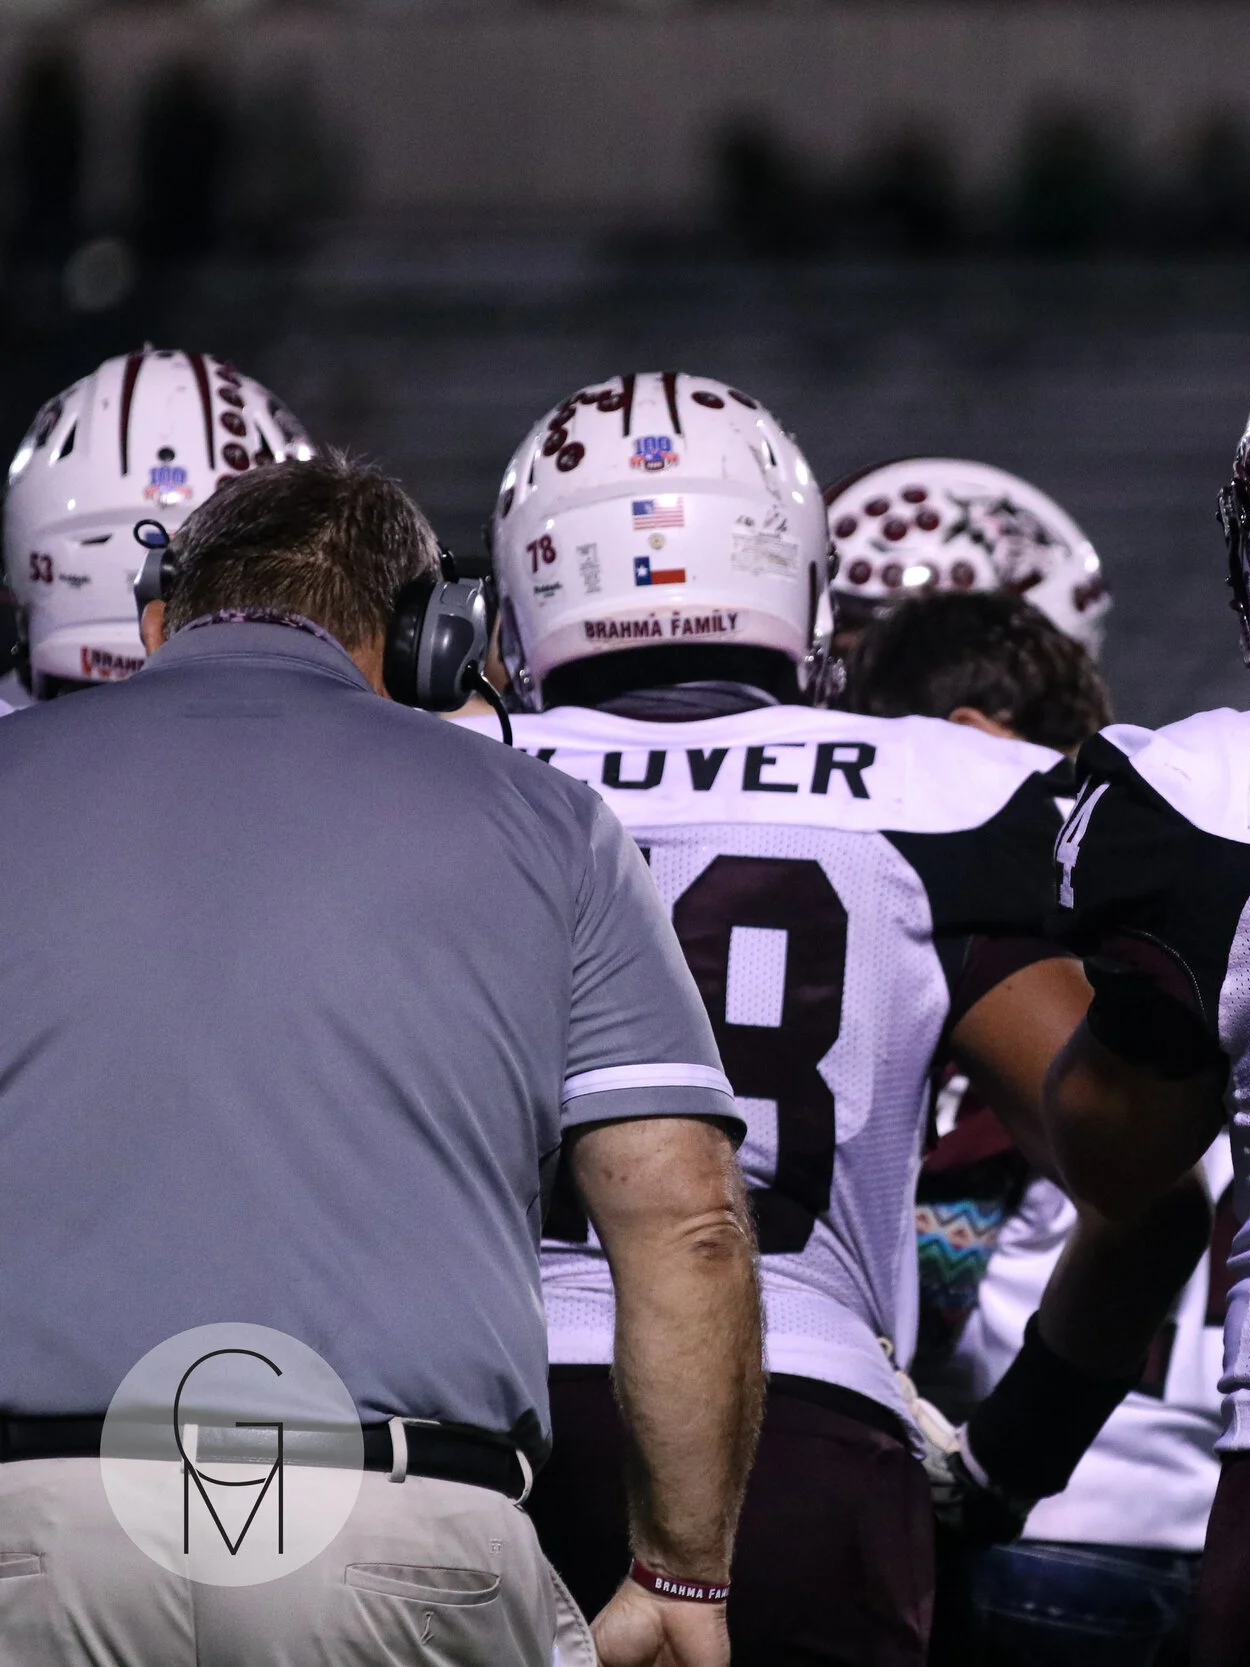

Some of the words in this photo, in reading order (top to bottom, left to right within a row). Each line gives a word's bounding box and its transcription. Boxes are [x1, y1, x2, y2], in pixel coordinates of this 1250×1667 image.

[634, 437, 671, 454] 100
[30, 552, 53, 583] 53
[526, 533, 556, 574] 78
[584, 620, 662, 639] BRAHMA
[671, 613, 738, 636] FAMILY
[520, 743, 876, 799] OVER
[655, 1577, 703, 1599] BRAHMA
